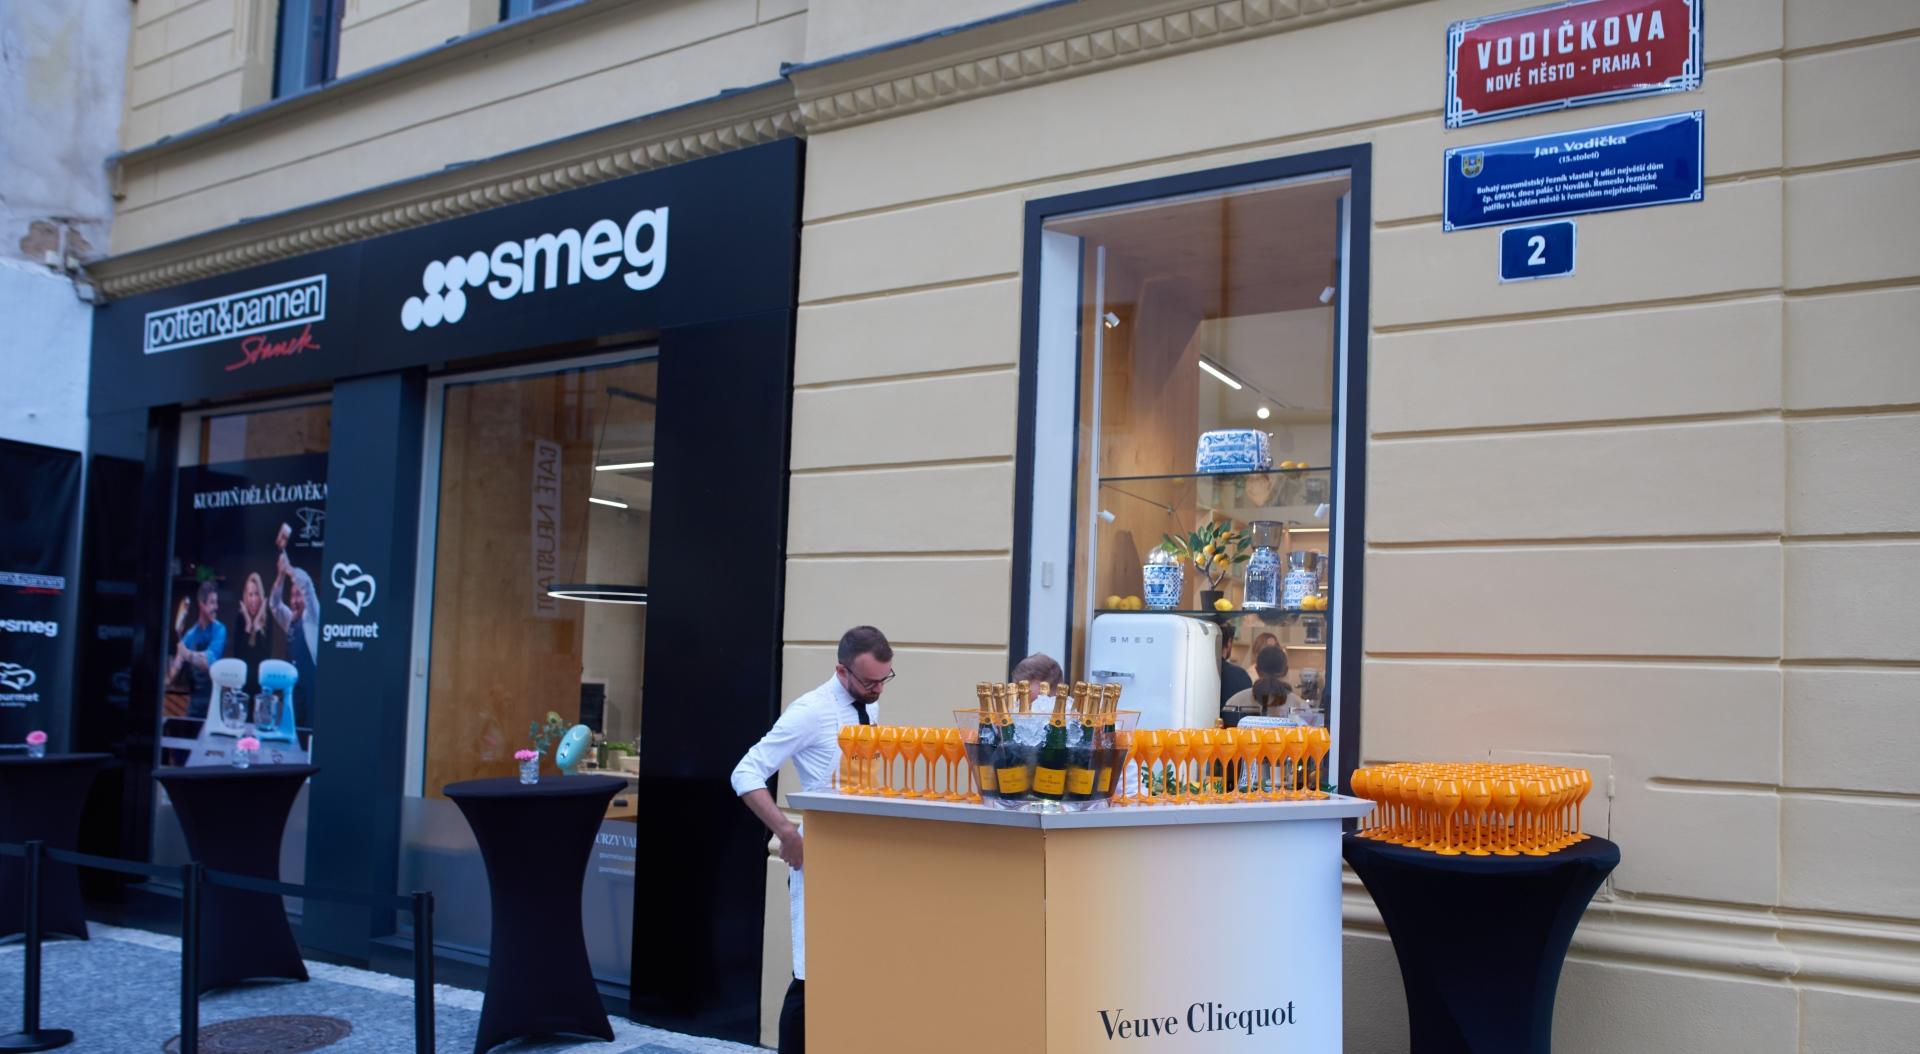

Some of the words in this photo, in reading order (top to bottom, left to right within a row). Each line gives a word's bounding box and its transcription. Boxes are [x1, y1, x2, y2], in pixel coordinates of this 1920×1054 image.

[1476, 10, 1665, 70] VODIČKOVA
[1486, 67, 1521, 93] NOVÉ
[1528, 62, 1575, 86] MĚSTO
[1592, 53, 1641, 75] PRAHA
[1645, 51, 1652, 67] 1
[1534, 146, 1559, 159] Jan
[1563, 135, 1627, 152] Vodička
[1477, 184, 1499, 195] Bohatý
[1601, 167, 1616, 177] ulici
[1617, 163, 1646, 175] největší
[1646, 163, 1664, 171] dům
[1518, 189, 1535, 198] dnes
[1535, 186, 1554, 197] palác
[1593, 176, 1625, 187] Řemeslo
[1483, 202, 1505, 214] patřilo
[1511, 197, 1538, 208] každém
[1539, 194, 1560, 204] městě
[1567, 187, 1602, 200] řemeslům
[488, 206, 669, 300] smeg
[1527, 235, 1546, 266] 2
[149, 284, 321, 350] potten&pannen
[193, 486, 240, 509] KUCHYŇ
[240, 483, 271, 506] DĚLÁ
[5, 619, 58, 637] smeg
[323, 621, 379, 642] gourmet
[1110, 636, 1154, 644] SMEG
[1097, 1008, 1179, 1041] Veuve
[1186, 1000, 1297, 1036] Clicquot
